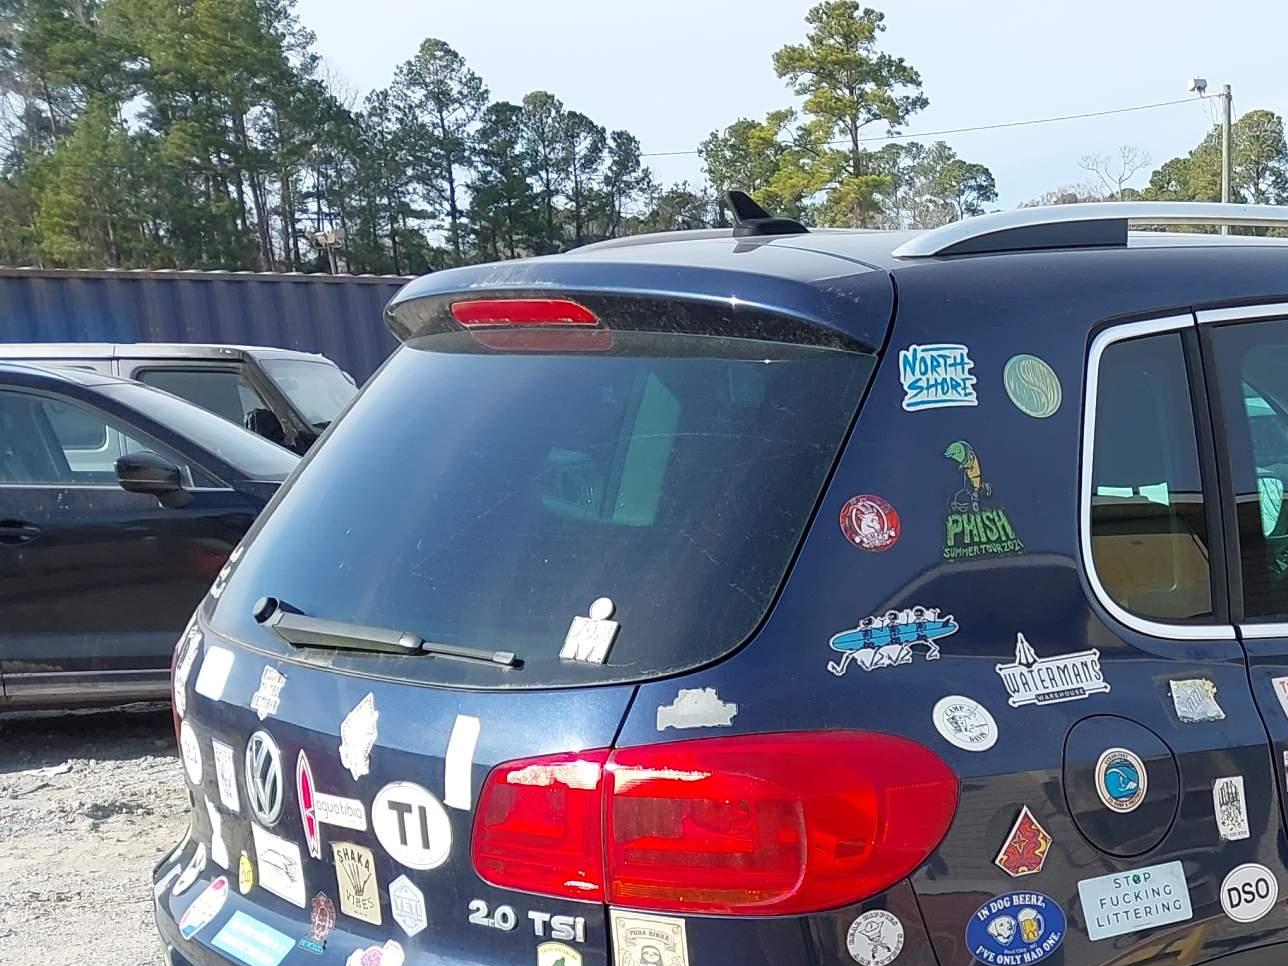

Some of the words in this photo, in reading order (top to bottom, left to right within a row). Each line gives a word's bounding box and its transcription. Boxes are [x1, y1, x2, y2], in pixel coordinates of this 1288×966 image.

[903, 348, 971, 381] NORTH
[907, 377, 974, 400] SHORE
[946, 509, 1016, 546] PHISH
[943, 545, 981, 558] SUMMER
[981, 542, 1003, 554] TOUR
[1003, 659, 1101, 693] WATERMANS
[1037, 688, 1085, 702] WAREHOUSE
[944, 706, 964, 717] CAMP
[388, 800, 430, 850] TI
[337, 847, 369, 873] SHAKA
[1113, 872, 1151, 888] STOP
[1227, 877, 1270, 909] DSO
[346, 889, 374, 910] VIBES
[977, 907, 990, 921] IN
[990, 897, 1011, 913] DOG
[1012, 894, 1046, 909] BEERZ,
[1099, 884, 1172, 909] FUCKING
[469, 900, 517, 930] 2.0
[528, 911, 585, 942] TSI
[1096, 900, 1182, 928] LITTERING
[976, 945, 996, 962] I'VE
[997, 954, 1022, 965] ONLY
[1024, 948, 1044, 962] HAD
[1042, 932, 1061, 950] ONE.
